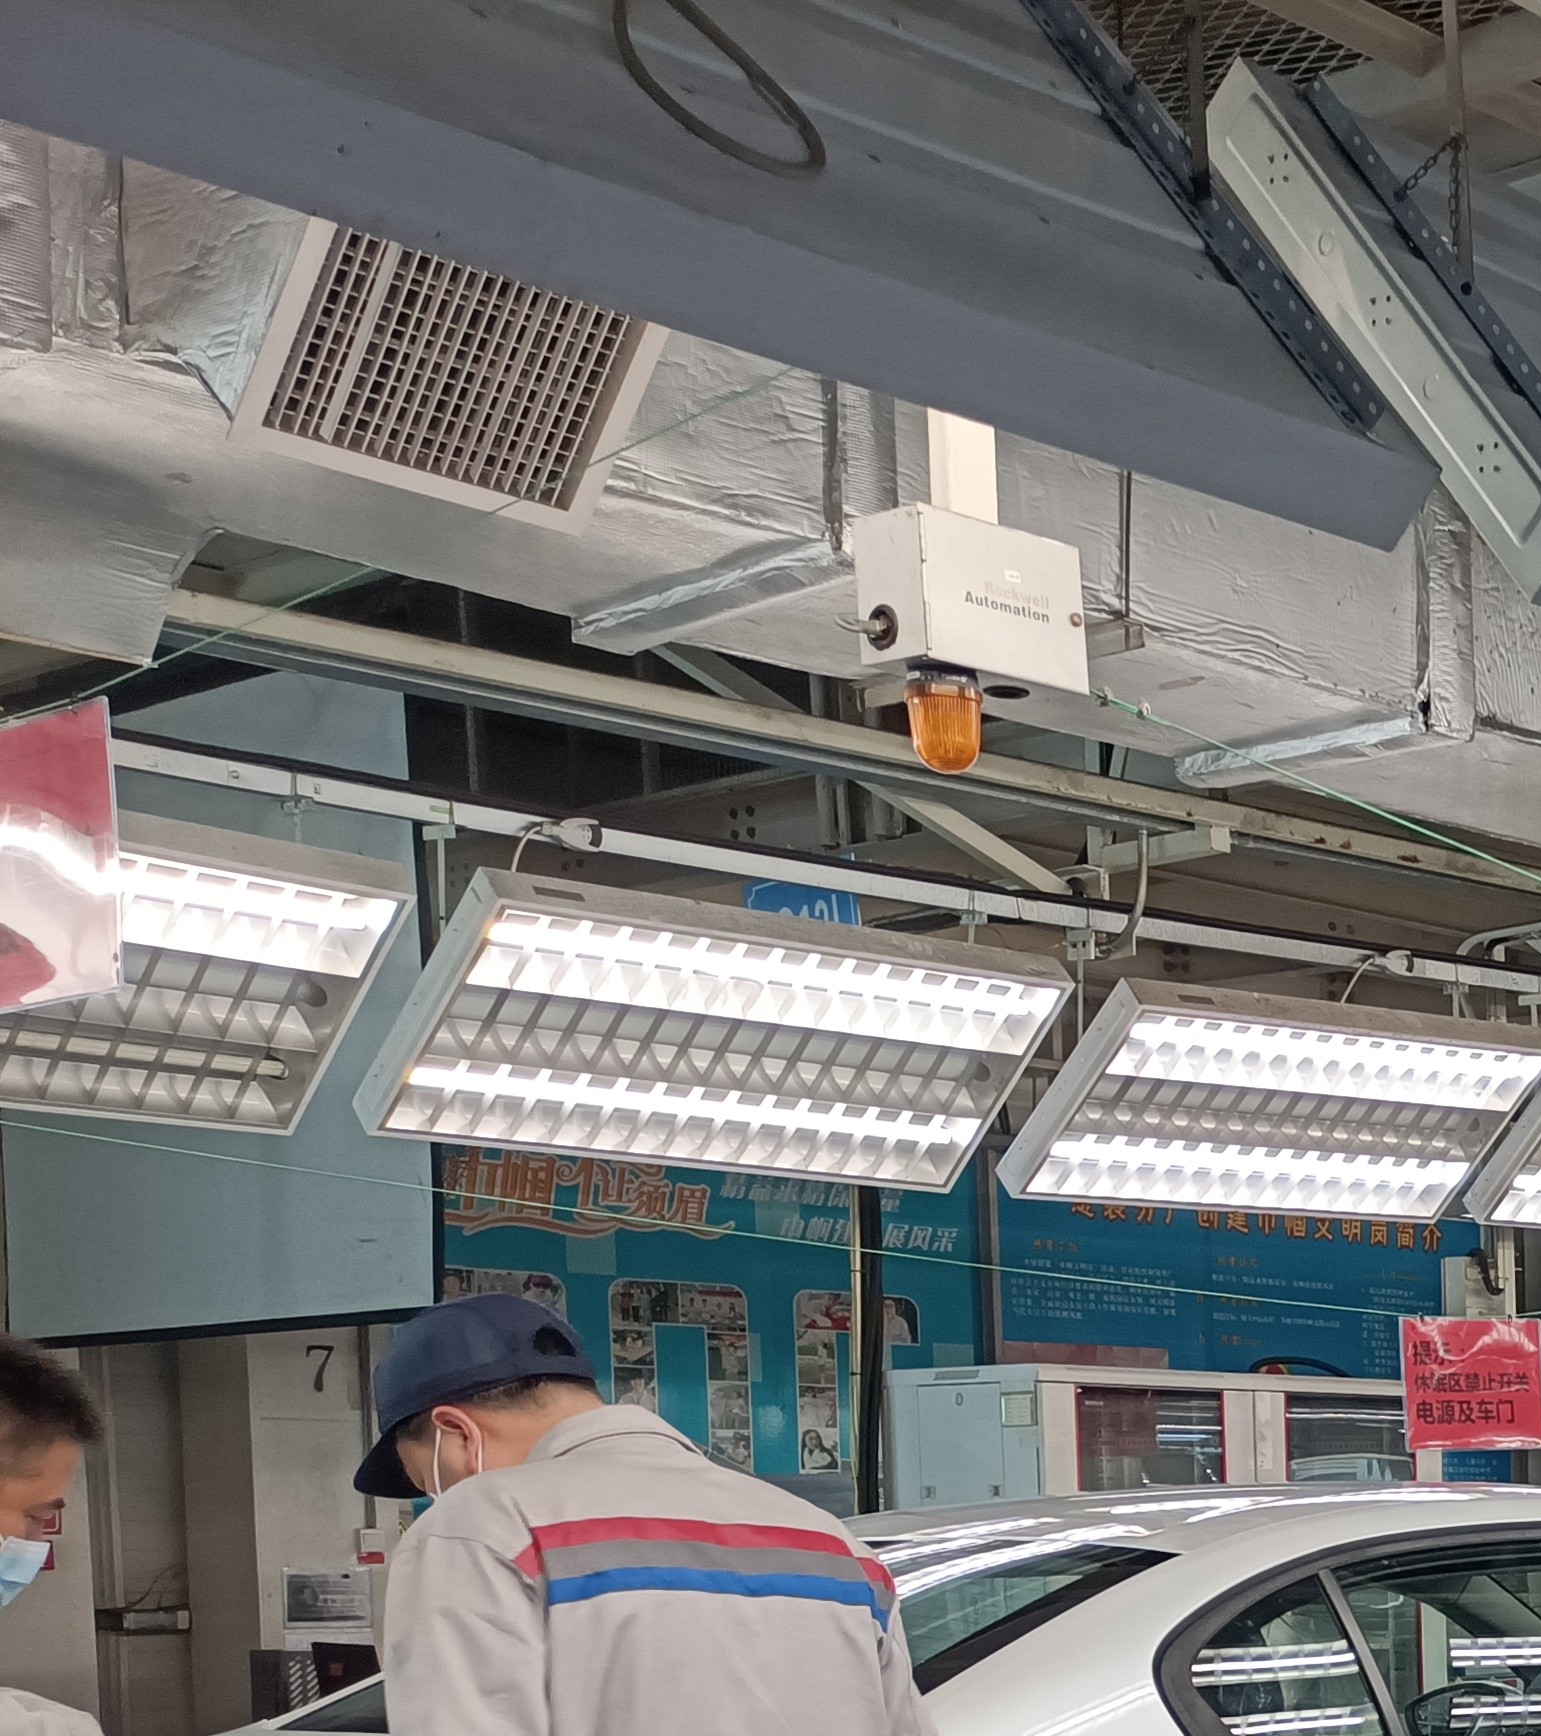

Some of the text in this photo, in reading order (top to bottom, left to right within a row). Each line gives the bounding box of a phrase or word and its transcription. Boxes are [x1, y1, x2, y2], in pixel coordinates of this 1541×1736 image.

[964, 590, 1050, 624] Automation
[984, 581, 1050, 609] Rockwell
[779, 1214, 959, 1253] 巾帼建展风采
[305, 1344, 334, 1393] 7
[1414, 1372, 1531, 1393] 休眠区禁止开关
[1415, 1398, 1516, 1426] 电源及车门
